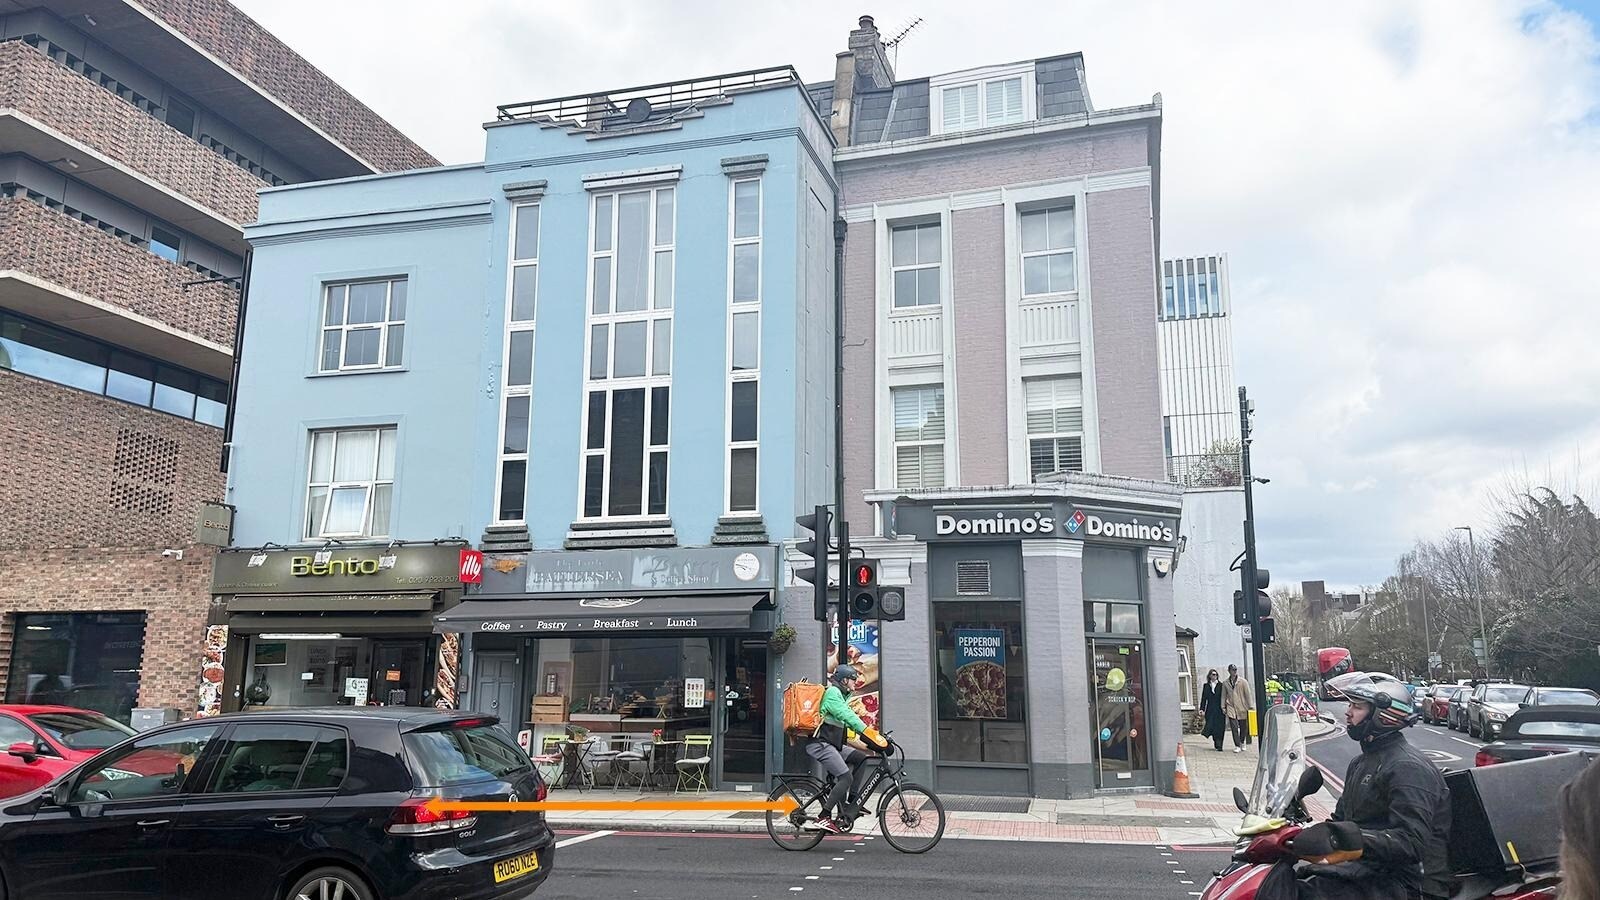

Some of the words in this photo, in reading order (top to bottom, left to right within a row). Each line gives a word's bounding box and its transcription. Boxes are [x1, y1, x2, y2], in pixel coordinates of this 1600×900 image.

[936, 512, 1054, 535] Domino's
[1087, 515, 1173, 542] Domino's
[290, 555, 379, 576] Bento
[461, 555, 482, 580] illy
[481, 622, 511, 631] Coffee
[536, 621, 567, 631] Pastry
[593, 619, 639, 628] Breakfast
[667, 618, 697, 627] Lunch
[959, 636, 1000, 647] PEPPERONI
[963, 647, 996, 657] PASSION
[459, 830, 477, 839] GOLF
[498, 857, 521, 878] RO60
[520, 852, 536, 871] NZE
